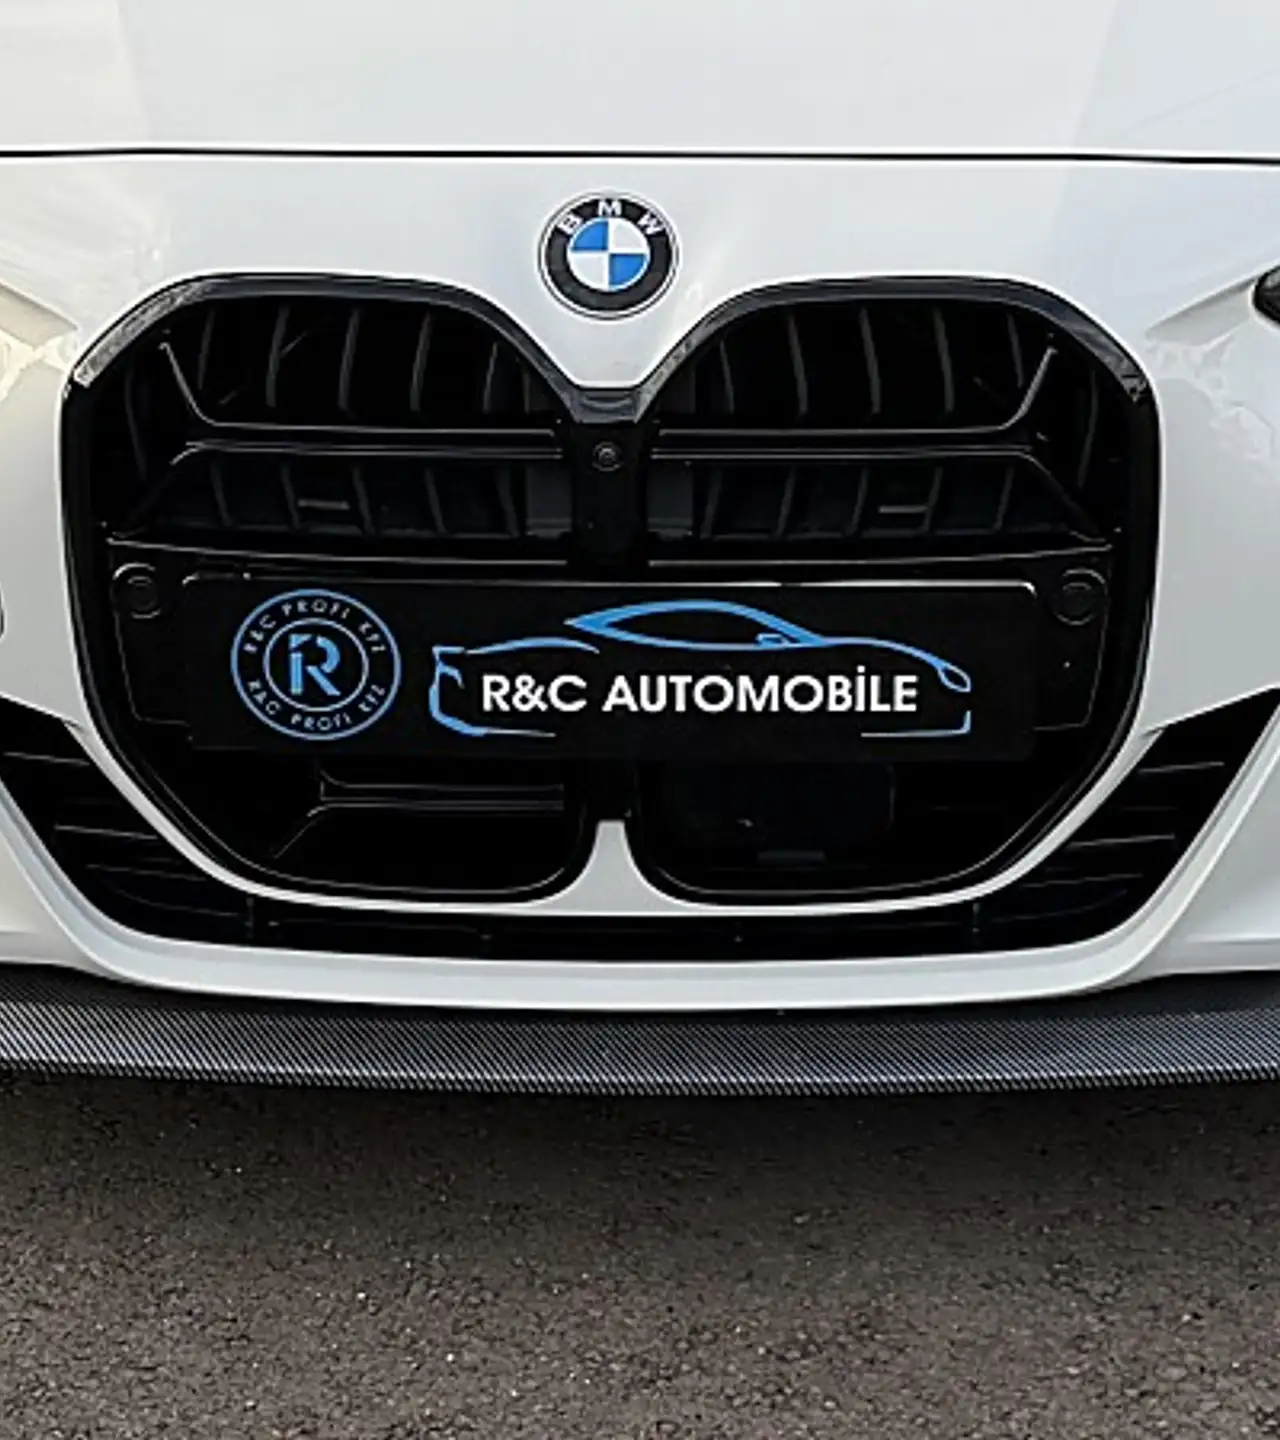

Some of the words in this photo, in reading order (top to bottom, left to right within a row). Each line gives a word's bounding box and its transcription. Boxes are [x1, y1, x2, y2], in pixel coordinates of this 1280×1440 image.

[558, 200, 665, 235] BMW
[289, 633, 341, 695] R
[482, 673, 587, 713] R&C
